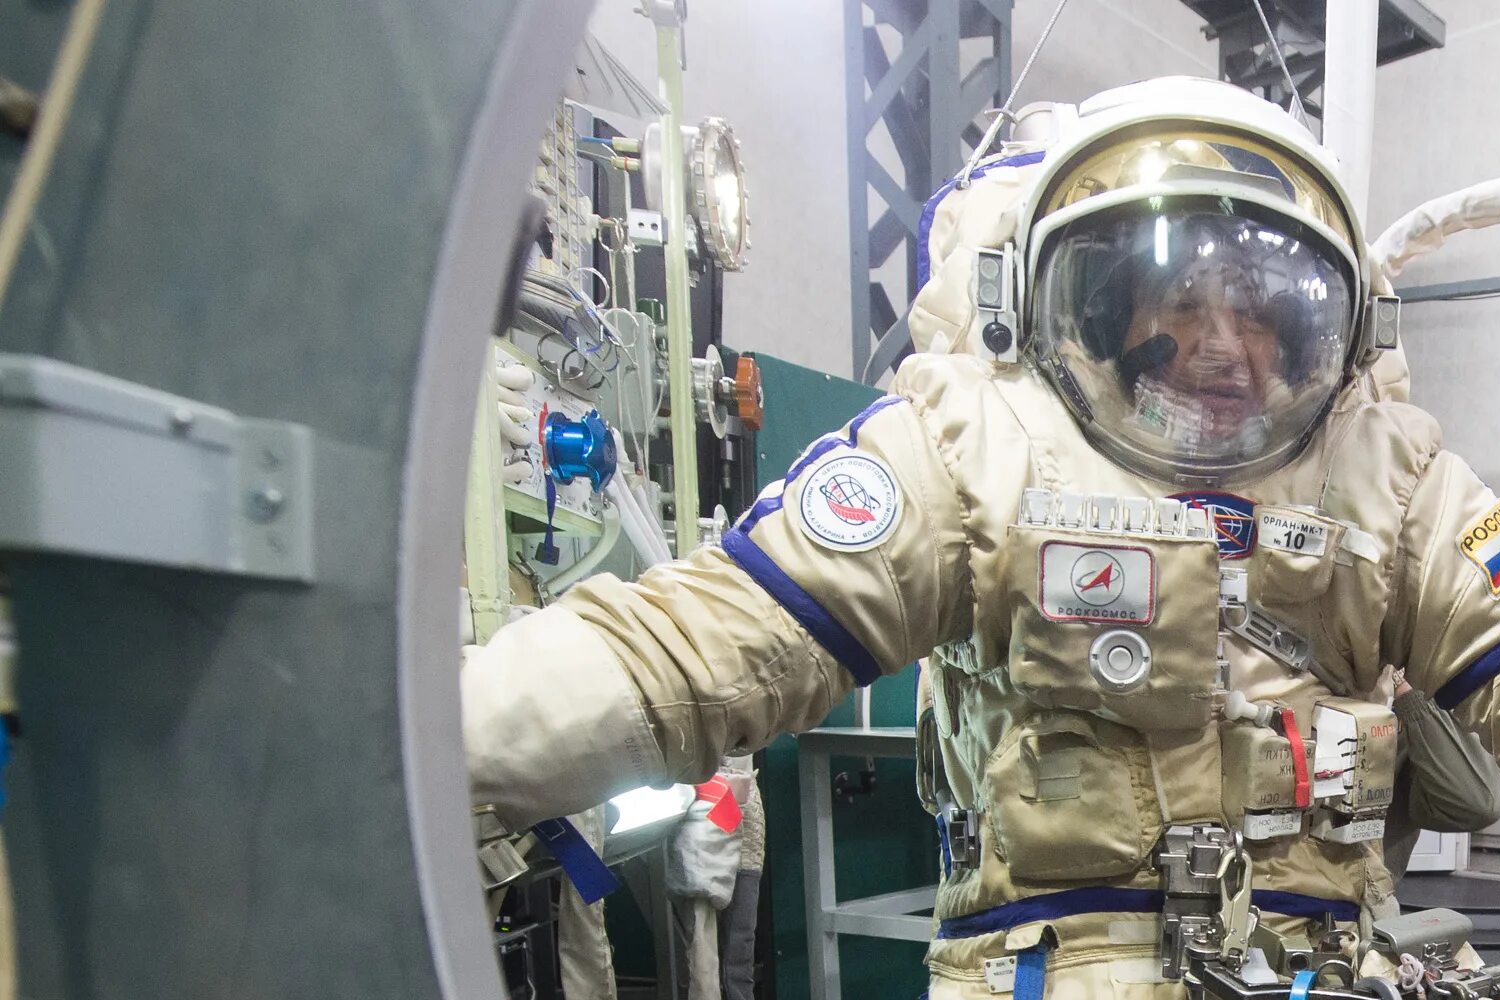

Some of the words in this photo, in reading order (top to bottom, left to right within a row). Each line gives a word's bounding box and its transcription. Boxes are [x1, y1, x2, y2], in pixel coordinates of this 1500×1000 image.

[1263, 515, 1323, 536] ОРЛАН-МК-Т
[1283, 530, 1306, 550] 10
[1057, 607, 1137, 619] РОСКОСМОС
